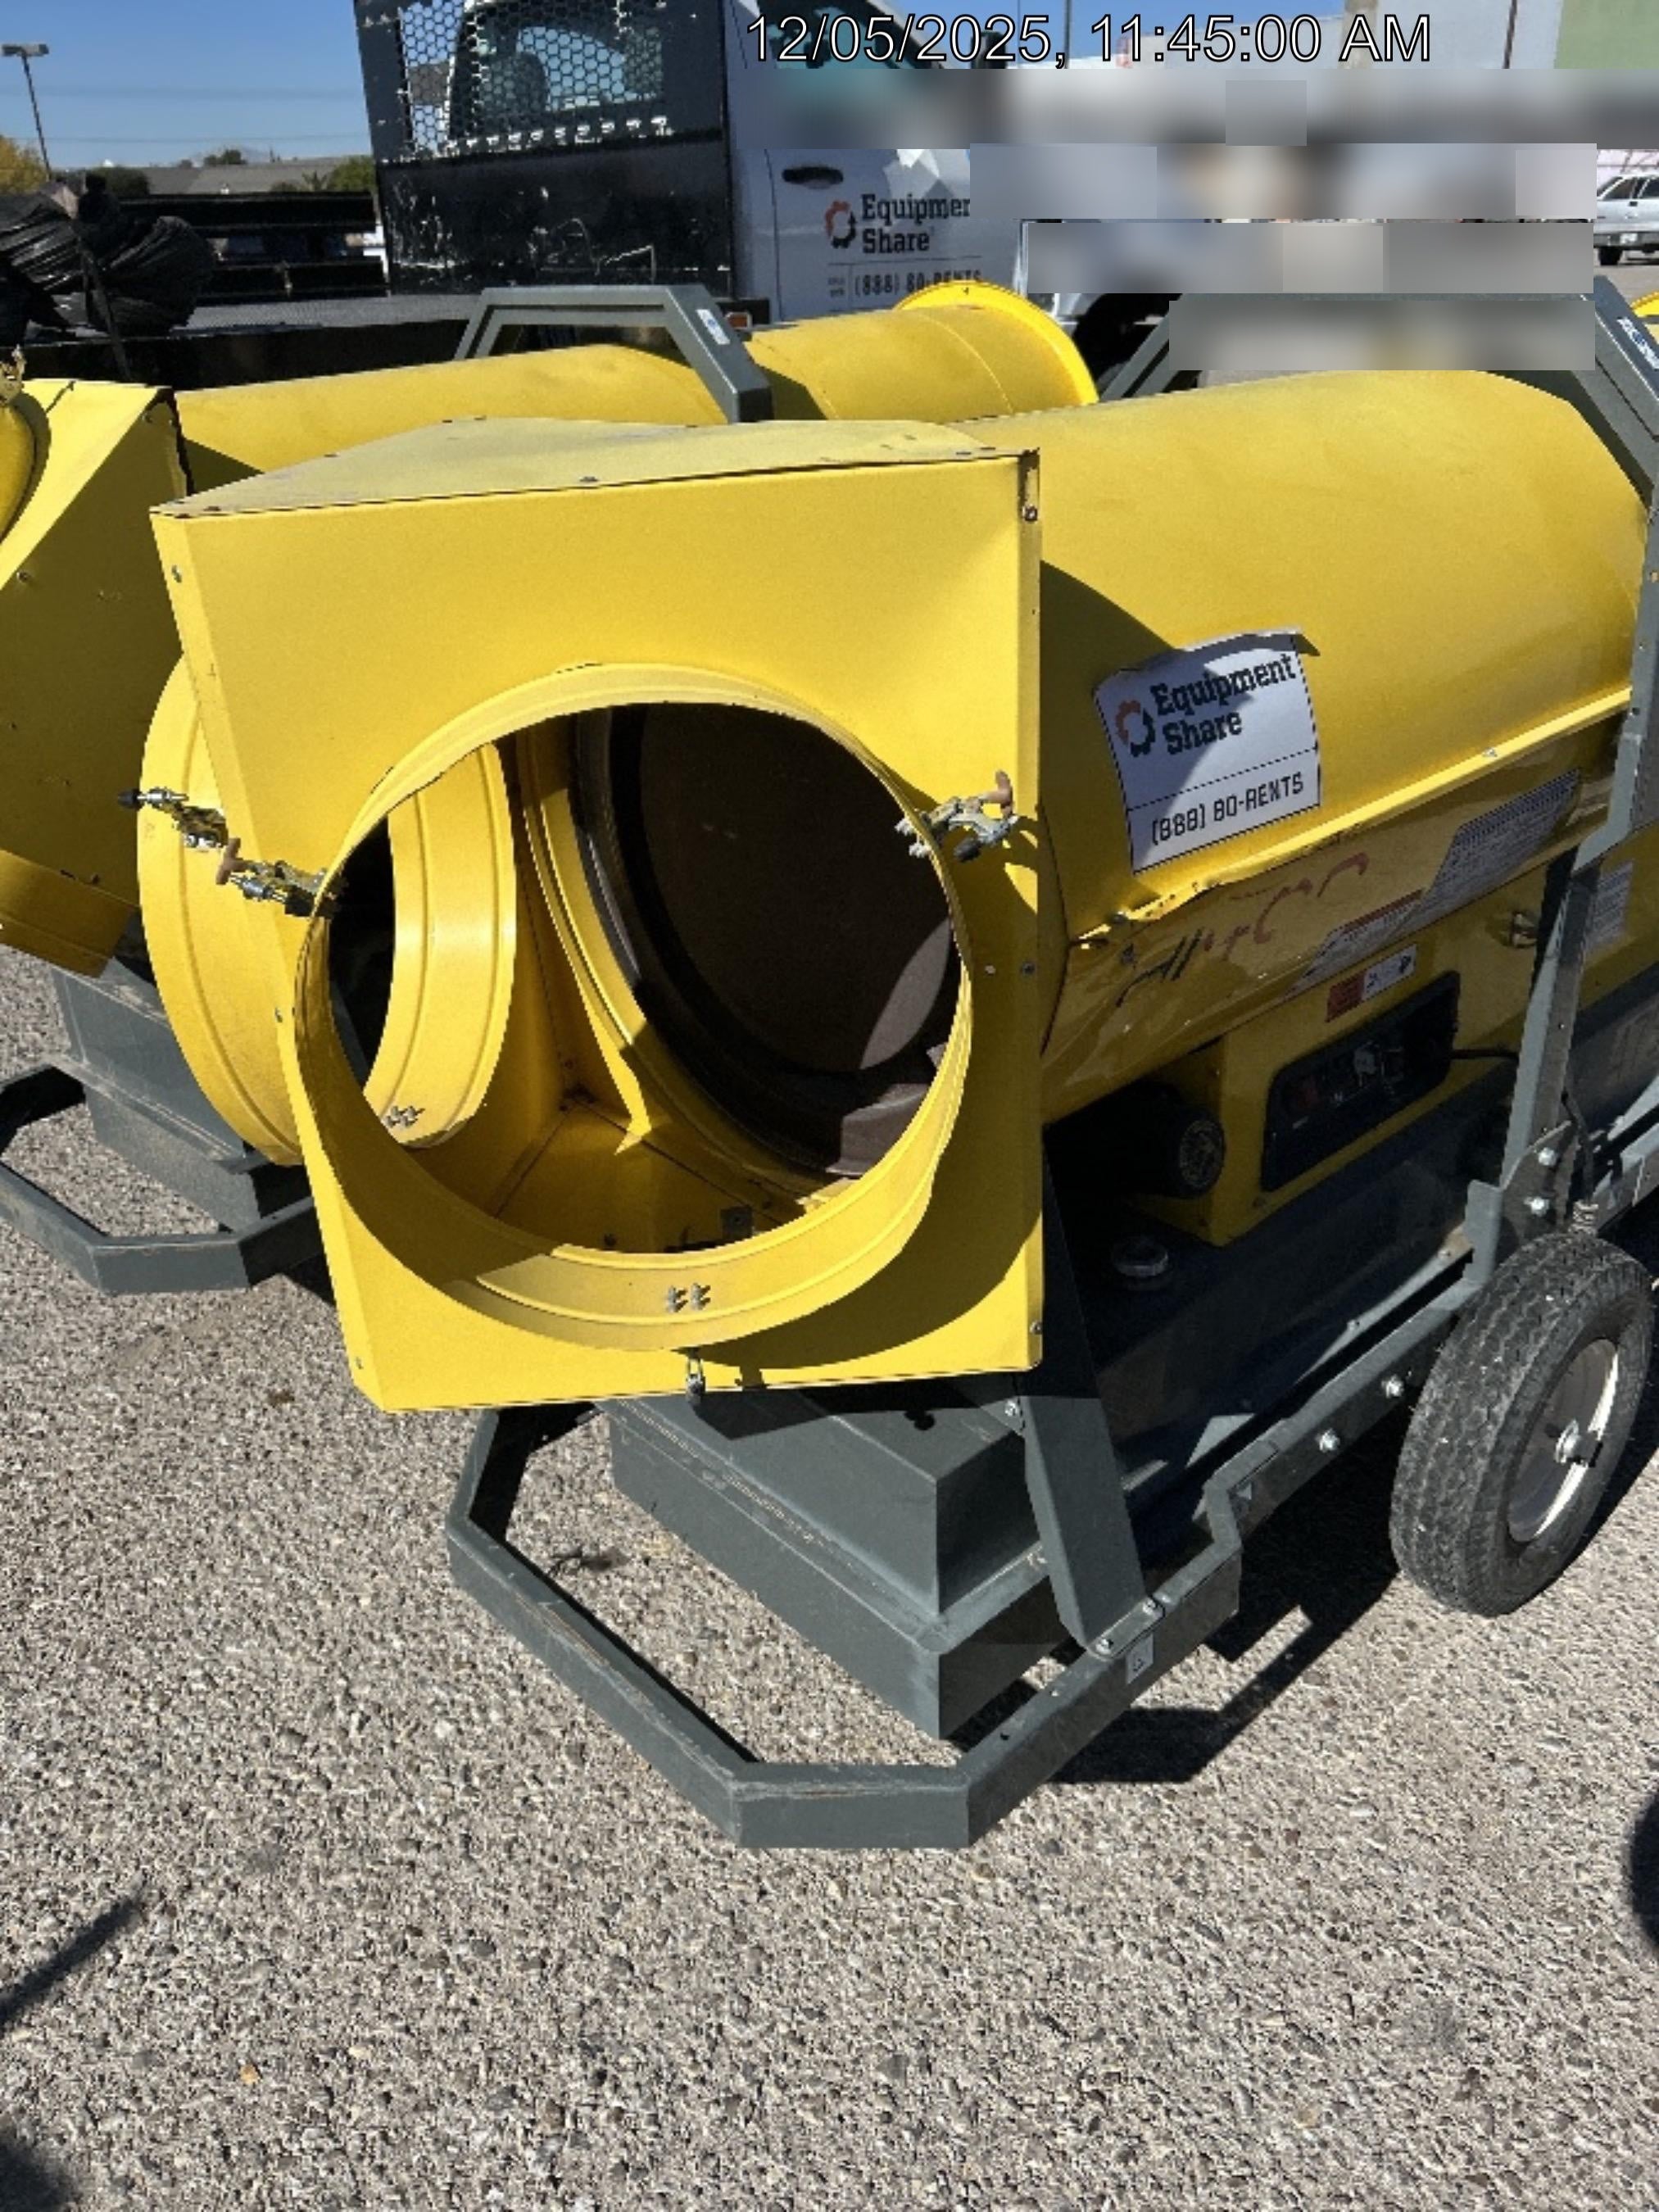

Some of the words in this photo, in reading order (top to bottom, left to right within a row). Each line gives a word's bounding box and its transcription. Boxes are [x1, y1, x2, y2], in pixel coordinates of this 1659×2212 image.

[863, 228, 930, 254] Share
[855, 274, 900, 297] (888)
[1150, 654, 1296, 715] Equipment
[1163, 711, 1242, 755] Share
[1152, 804, 1206, 845] (888)
[1213, 773, 1304, 823] 80-RENTS
